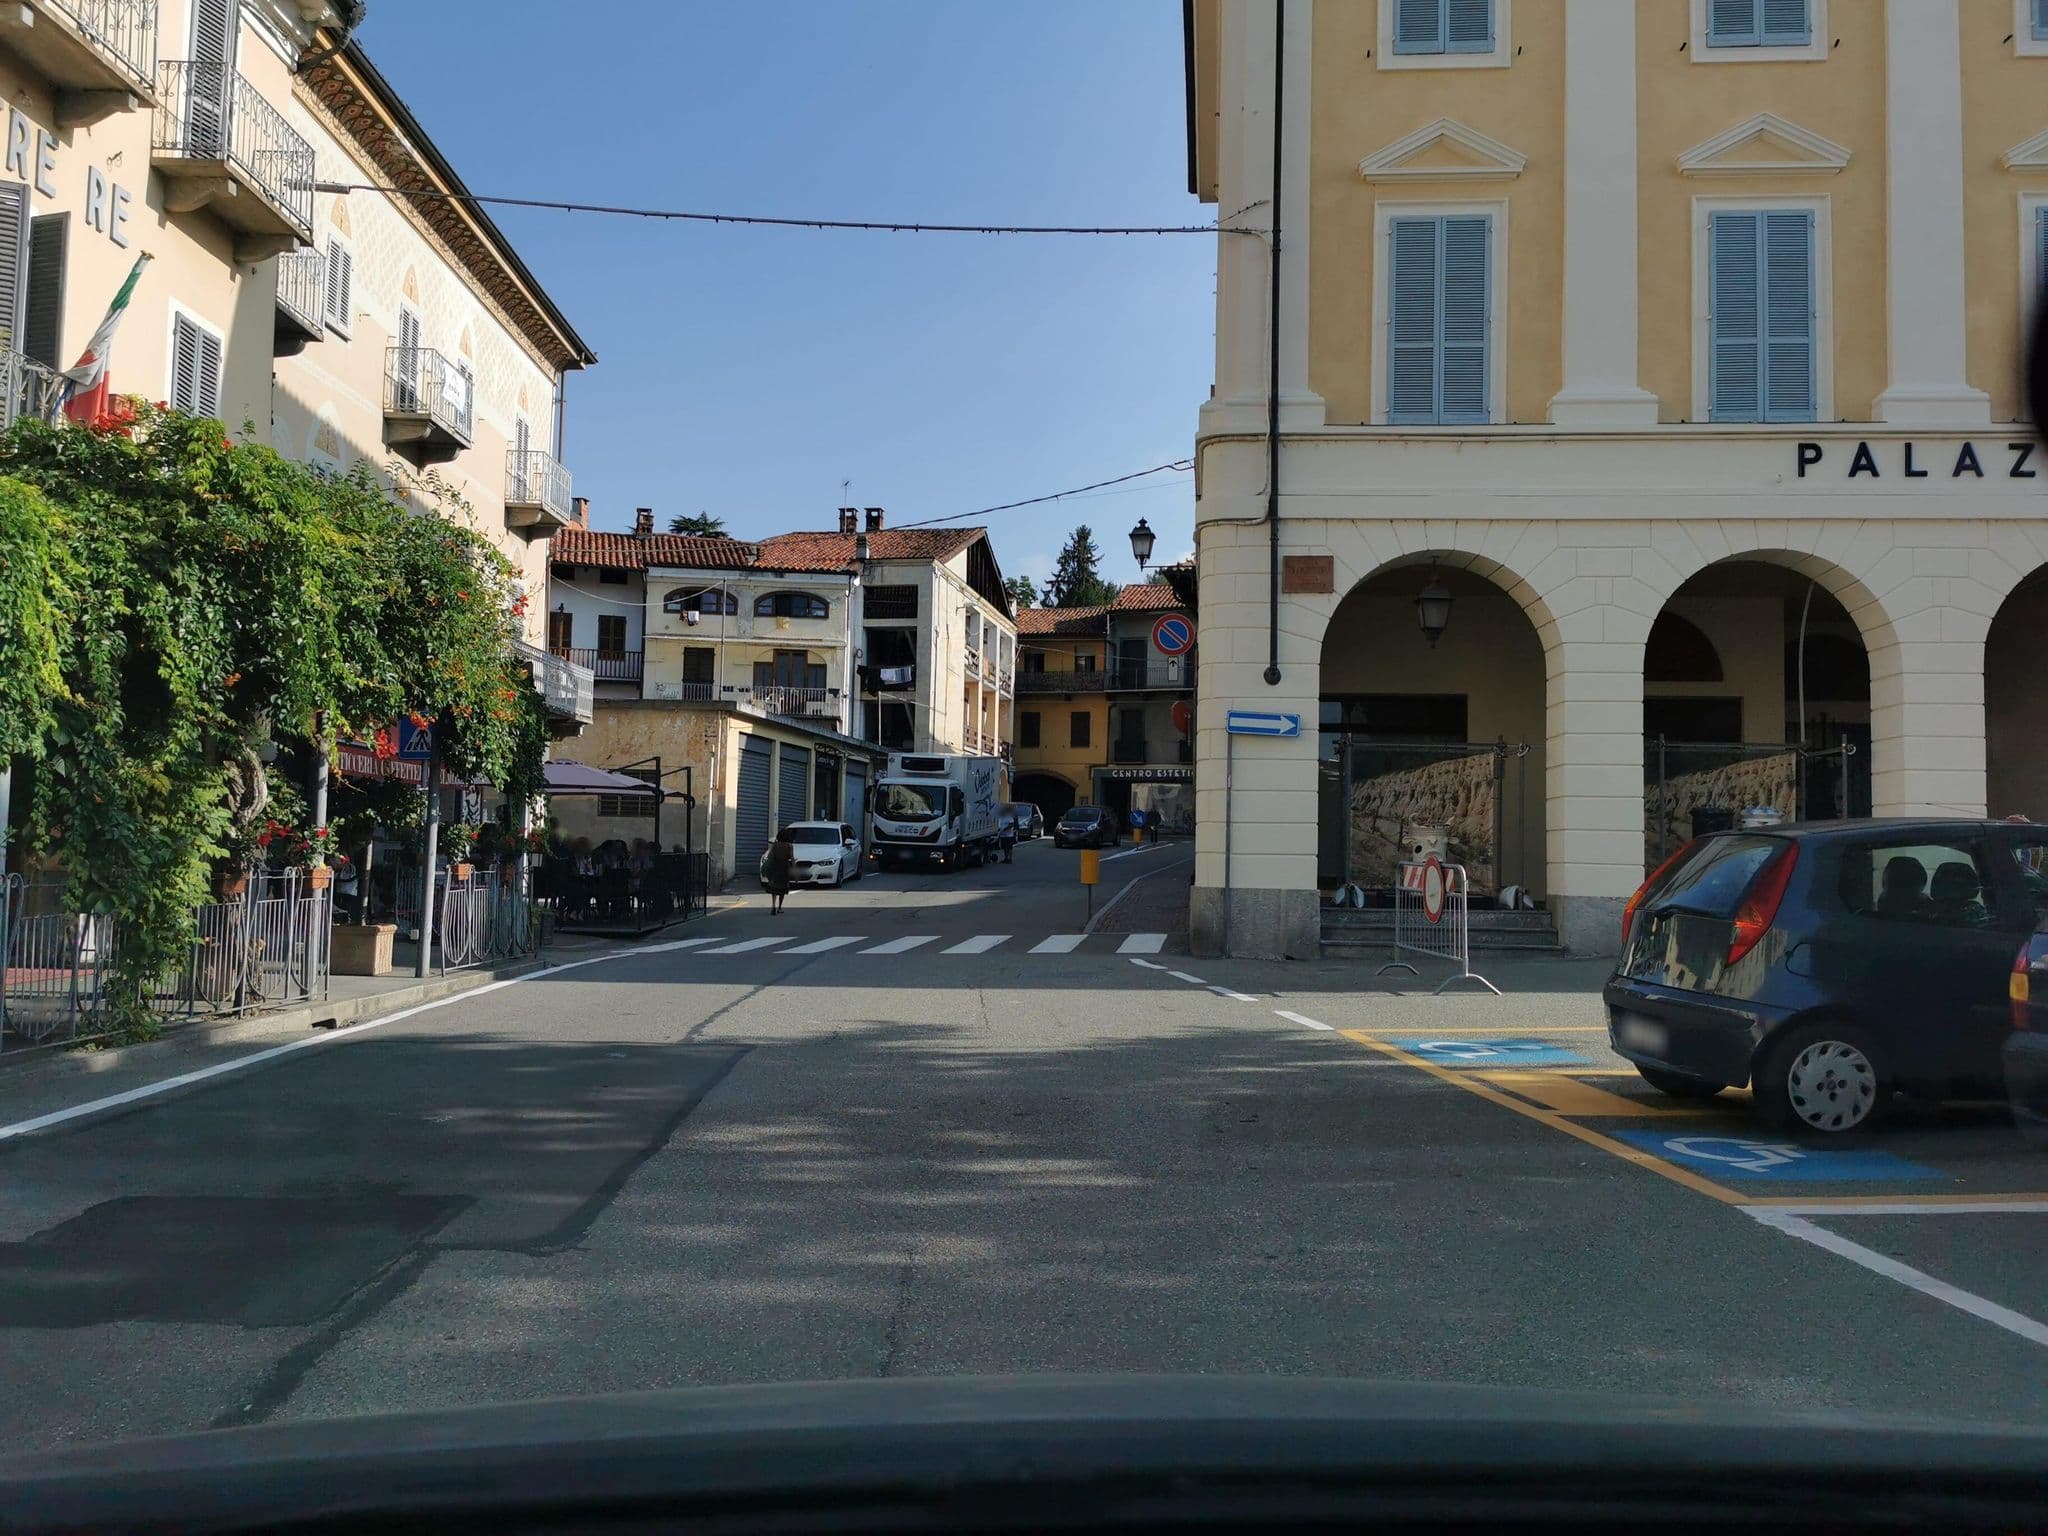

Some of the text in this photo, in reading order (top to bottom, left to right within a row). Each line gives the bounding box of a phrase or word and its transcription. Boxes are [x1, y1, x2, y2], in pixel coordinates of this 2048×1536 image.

[0, 98, 131, 249] RE RE
[1797, 441, 2037, 478] PALAZ
[1112, 769, 1194, 778] CENTRO ESTETI
